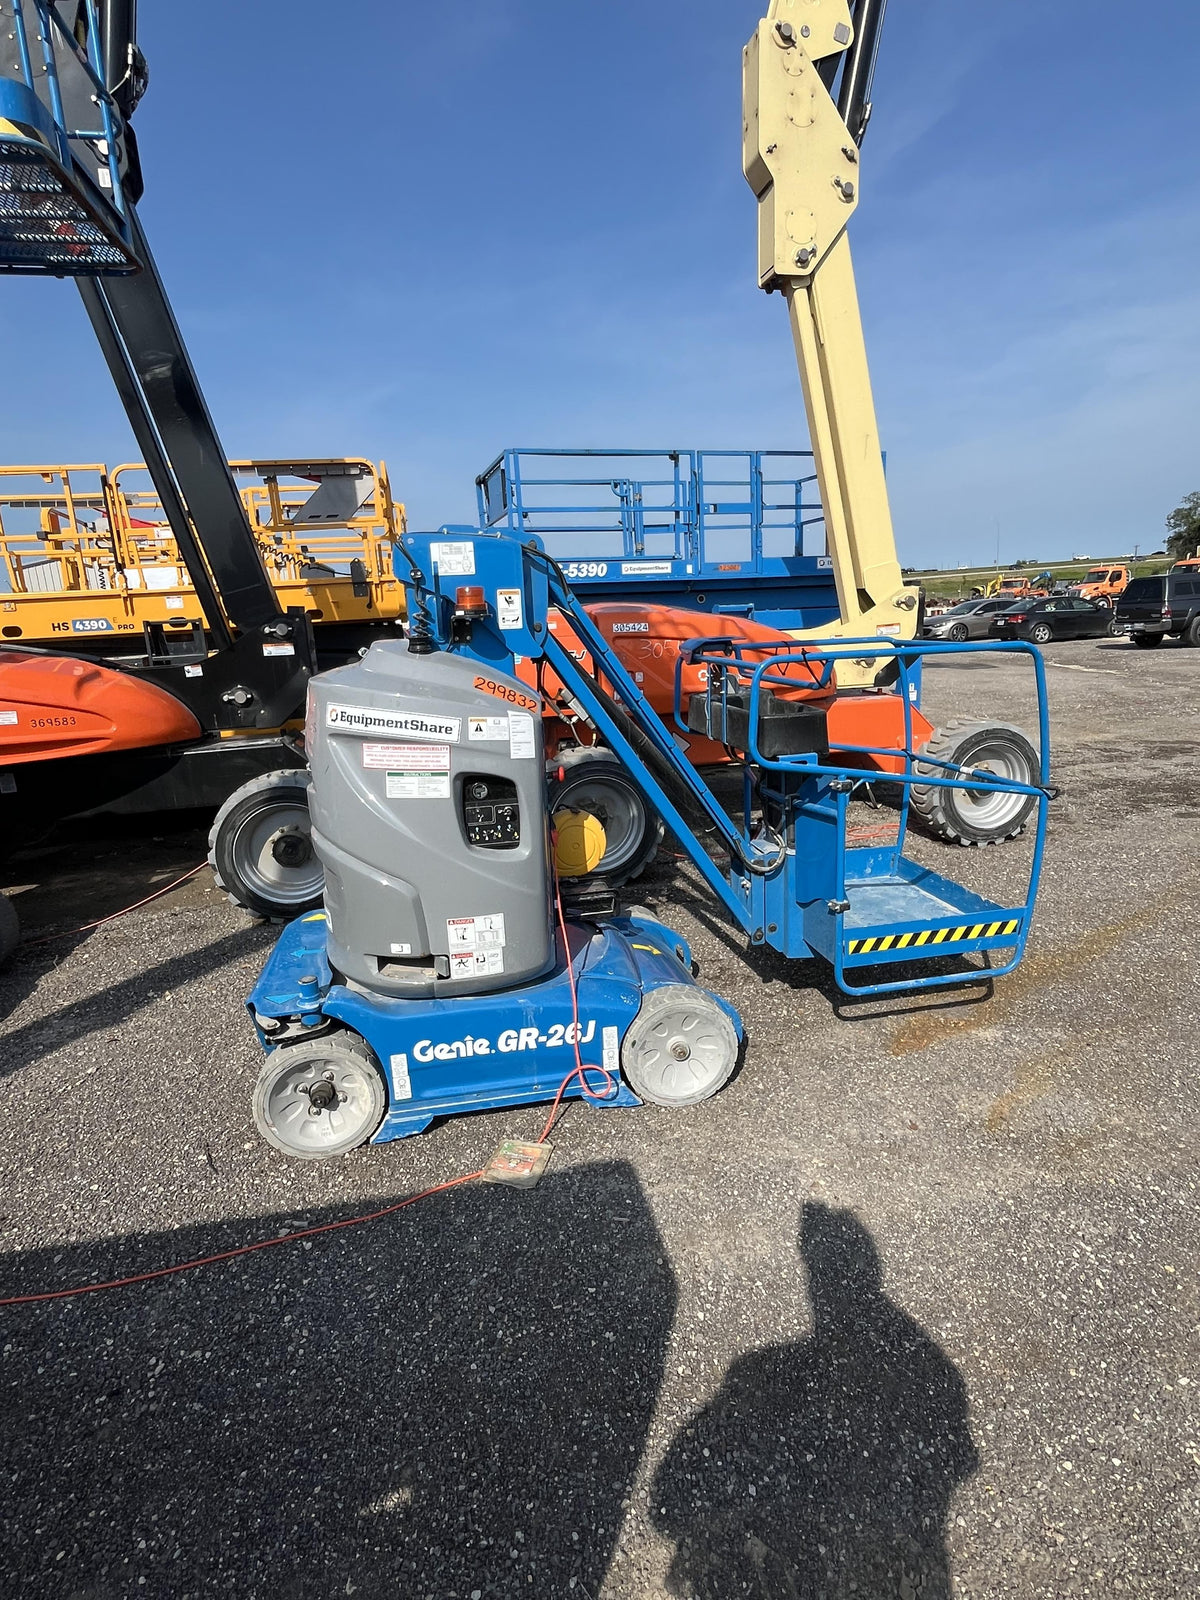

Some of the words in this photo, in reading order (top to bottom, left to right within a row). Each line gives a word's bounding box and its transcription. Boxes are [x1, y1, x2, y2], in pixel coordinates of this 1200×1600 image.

[51, 622, 70, 632] HS
[75, 619, 107, 631] 4390
[117, 623, 135, 631] PRO
[614, 623, 649, 632] 305424
[474, 676, 537, 714] 299832
[30, 716, 77, 728] 369583
[340, 710, 453, 735] EquipmentShare
[497, 1020, 597, 1053] GR-26J
